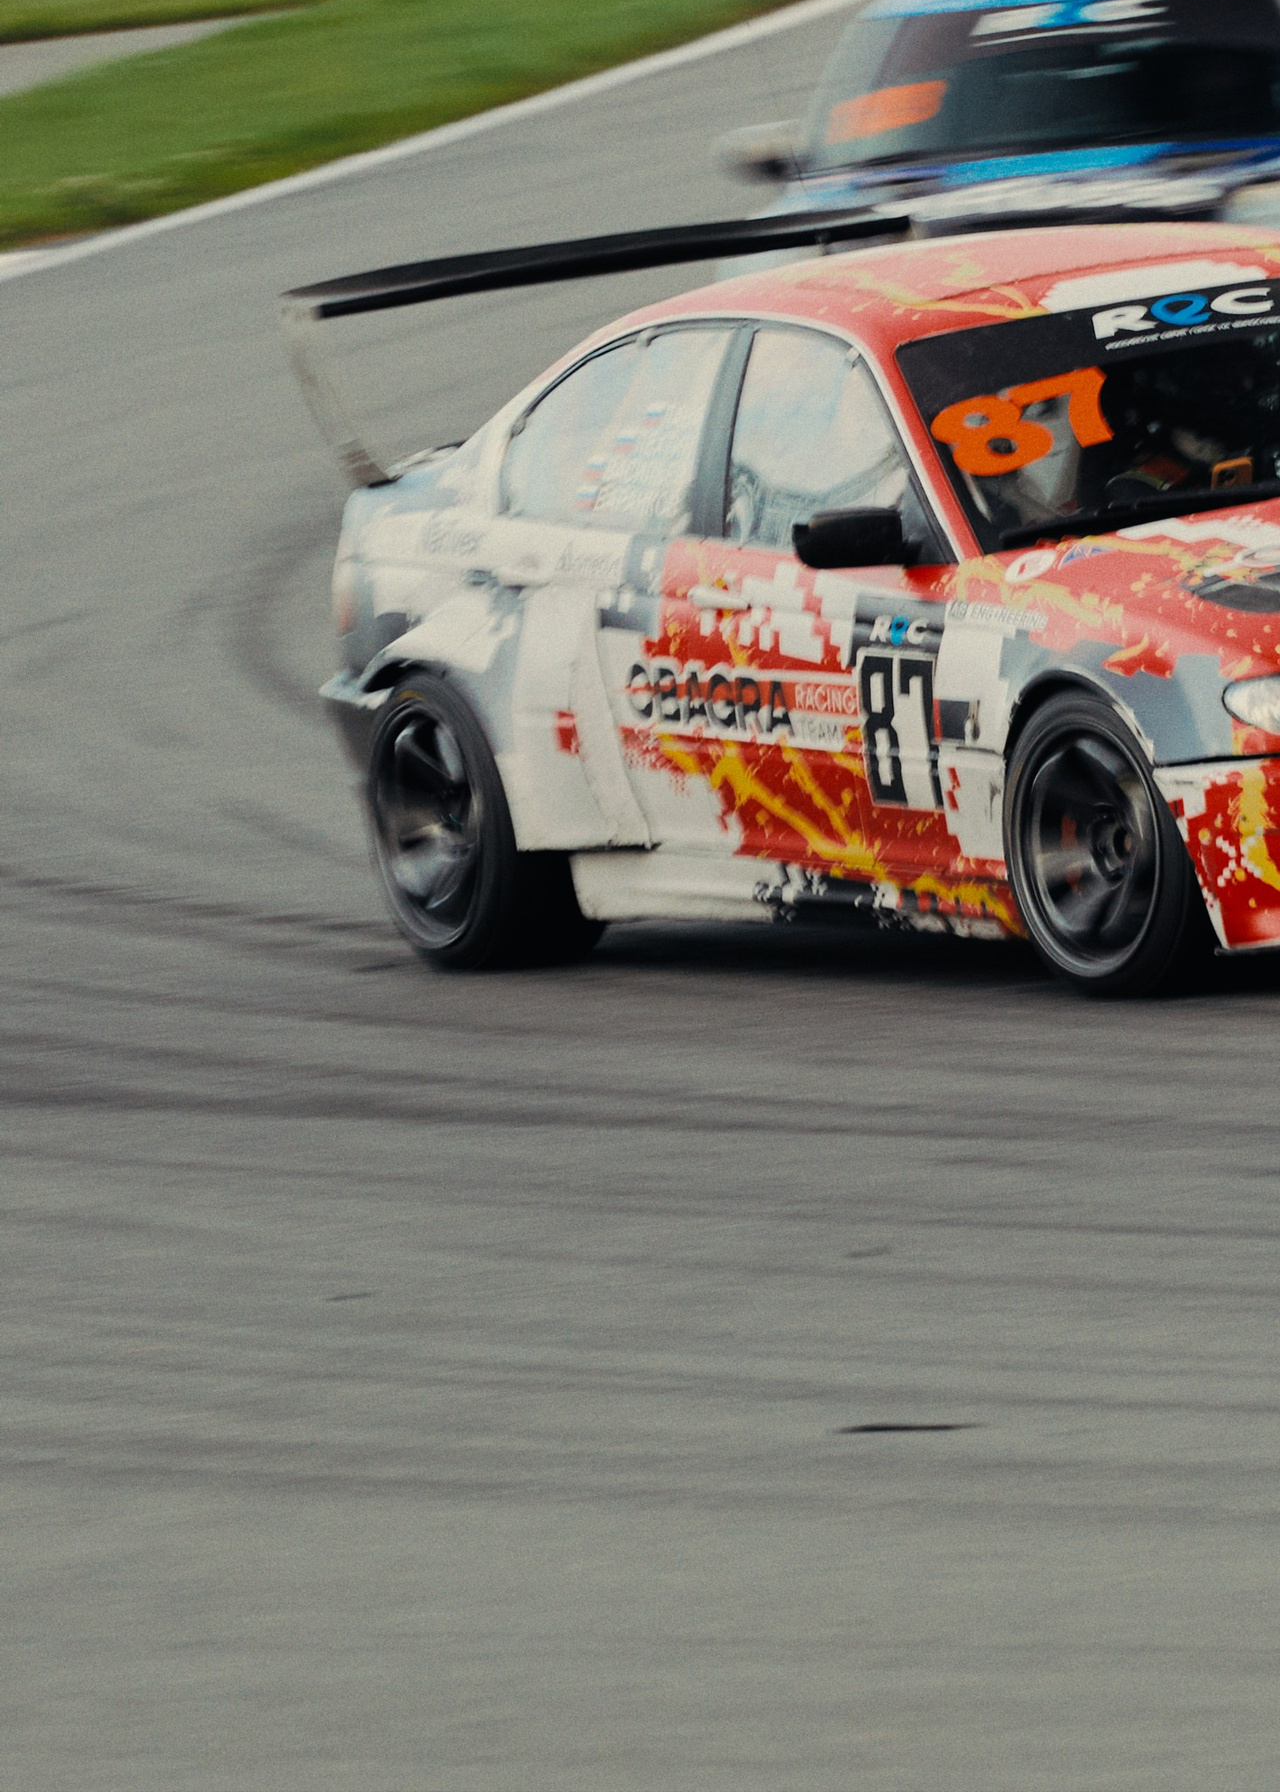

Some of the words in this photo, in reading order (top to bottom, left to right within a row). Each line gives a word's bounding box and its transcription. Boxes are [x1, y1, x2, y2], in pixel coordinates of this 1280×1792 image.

[930, 365, 1115, 476] 87
[625, 662, 795, 738] OBAGRA
[795, 684, 857, 714] RACING
[800, 715, 842, 742] TEAM
[859, 653, 944, 808] 87
